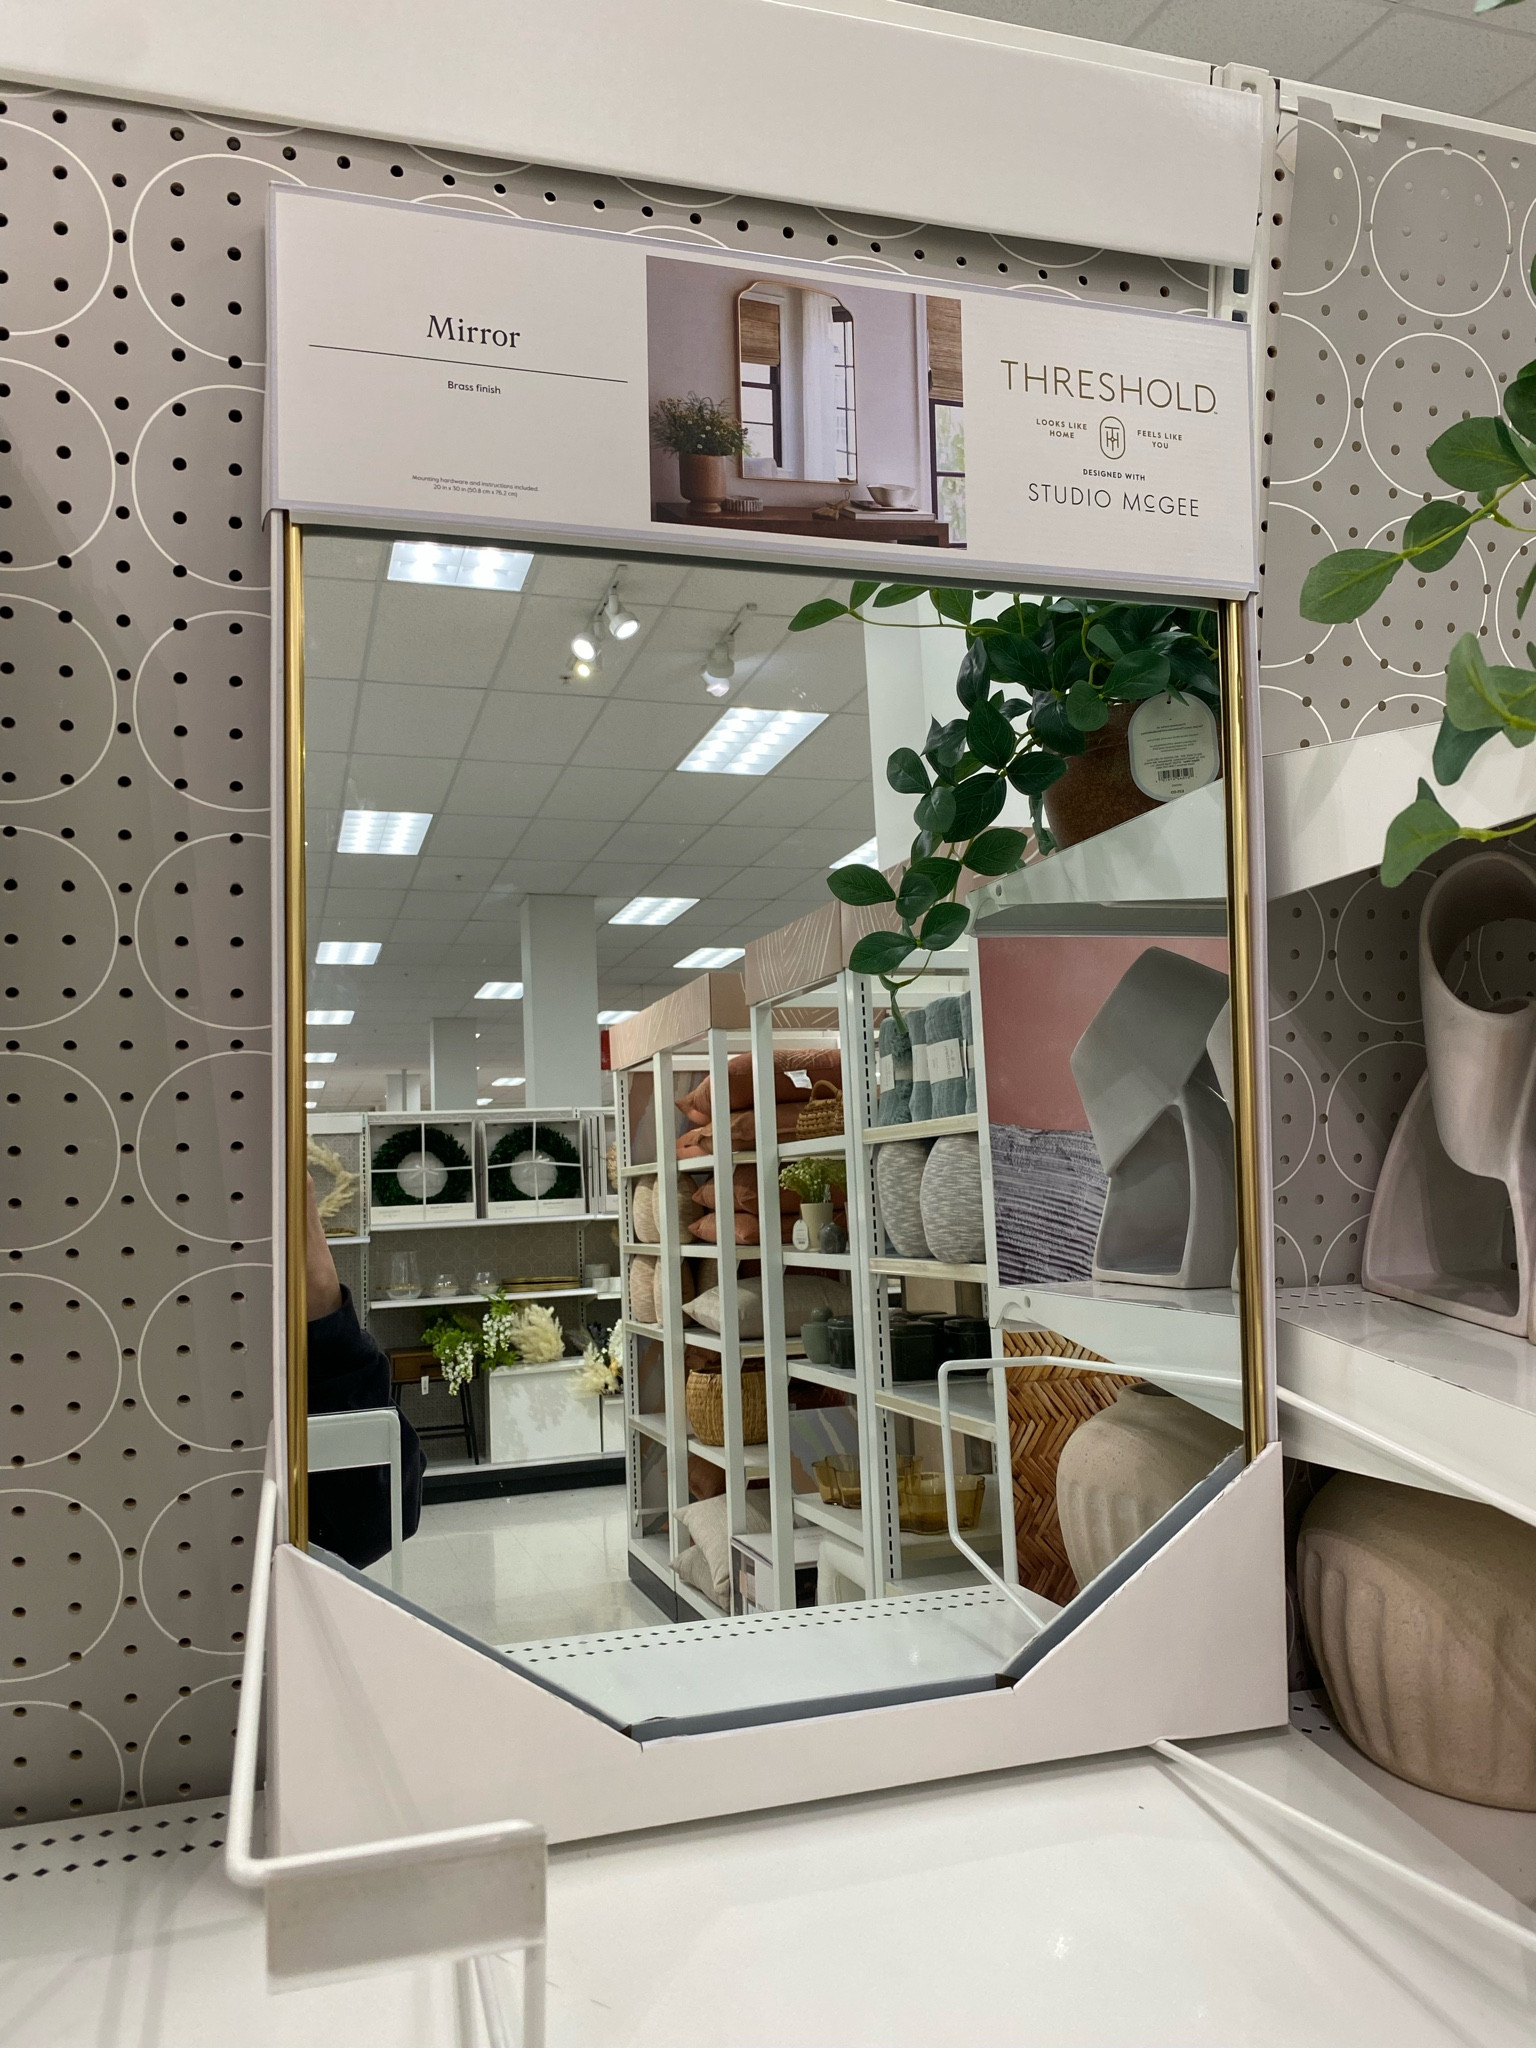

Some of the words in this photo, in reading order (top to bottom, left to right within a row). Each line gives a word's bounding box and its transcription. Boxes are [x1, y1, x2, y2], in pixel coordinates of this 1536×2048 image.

[426, 314, 521, 348] Mirror
[447, 380, 474, 392] Brass
[476, 383, 501, 395] finish
[1036, 418, 1066, 428] LOOKS
[1068, 422, 1088, 431] LIKE
[1049, 430, 1075, 439] HOME
[1137, 429, 1162, 439] FEELS
[1164, 432, 1183, 441] LIKE
[1151, 441, 1169, 449] YOU
[1082, 468, 1123, 479] DESIGNED
[1124, 472, 1146, 481] WITH
[411, 474, 440, 483] Mounting
[440, 476, 468, 486] hardware
[481, 481, 514, 489] instructions
[1028, 482, 1111, 508] STUDIO
